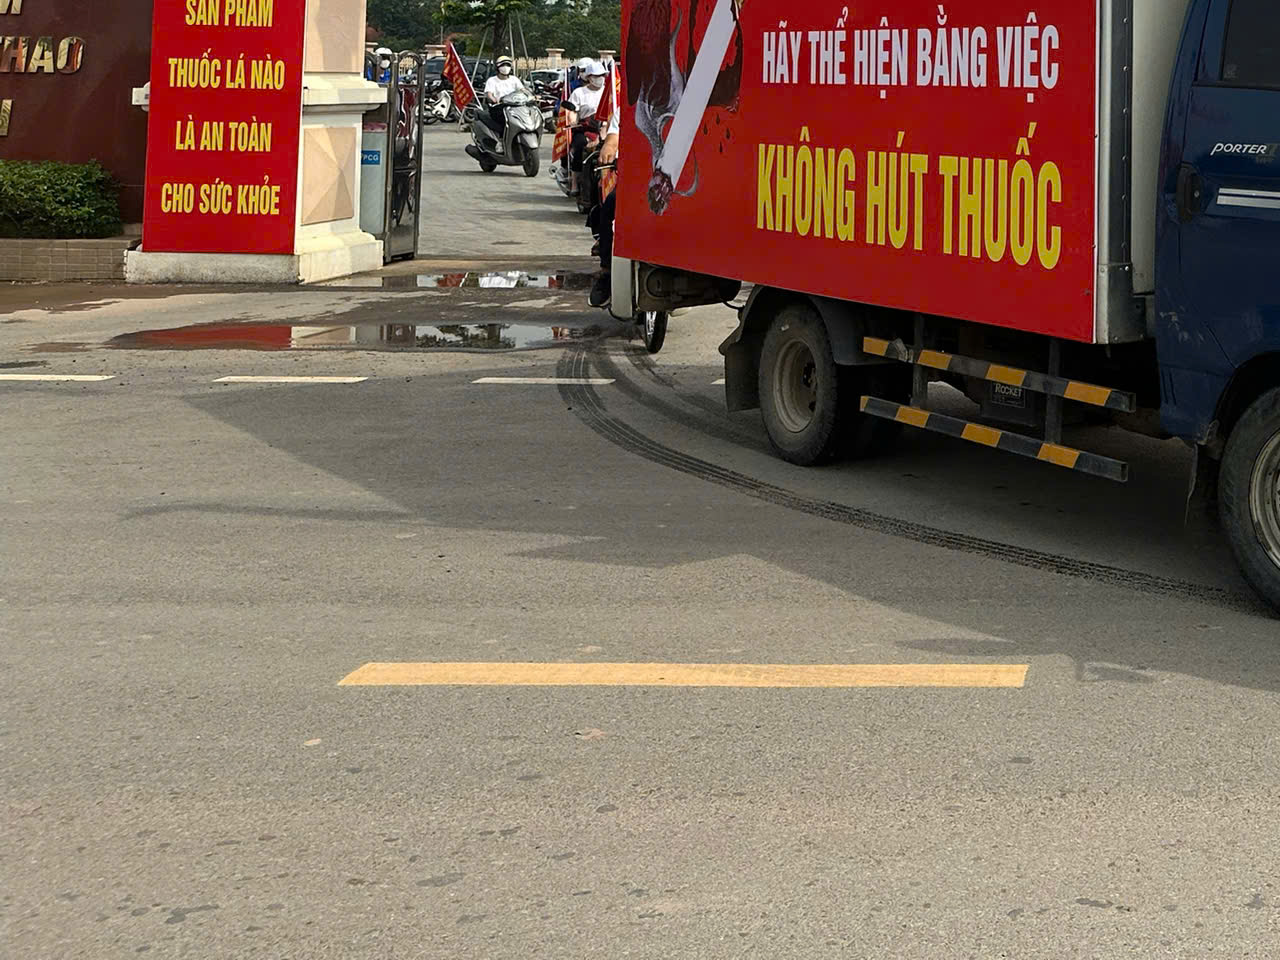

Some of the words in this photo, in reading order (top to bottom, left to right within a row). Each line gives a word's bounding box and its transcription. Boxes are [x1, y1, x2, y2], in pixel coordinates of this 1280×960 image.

[168, 48, 221, 89] THUỐC
[225, 52, 247, 90] LÁ
[250, 50, 285, 91] NÀO
[762, 22, 802, 85] HÃY
[808, 6, 848, 85] THỂ
[853, 16, 908, 100] HIỆN
[916, 4, 988, 88] BẰNG
[996, 11, 1060, 104] VIỆC
[175, 114, 196, 151] LÀ
[200, 122, 224, 152] AN
[228, 115, 272, 153] TOÀN
[1210, 142, 1268, 156] PORTER
[161, 182, 194, 213] CHO
[199, 178, 232, 215] SỨC
[237, 174, 281, 216] KHỎE
[756, 126, 855, 243] KHÔNG
[864, 131, 928, 251] HÚT
[938, 121, 1062, 271] THUỐC
